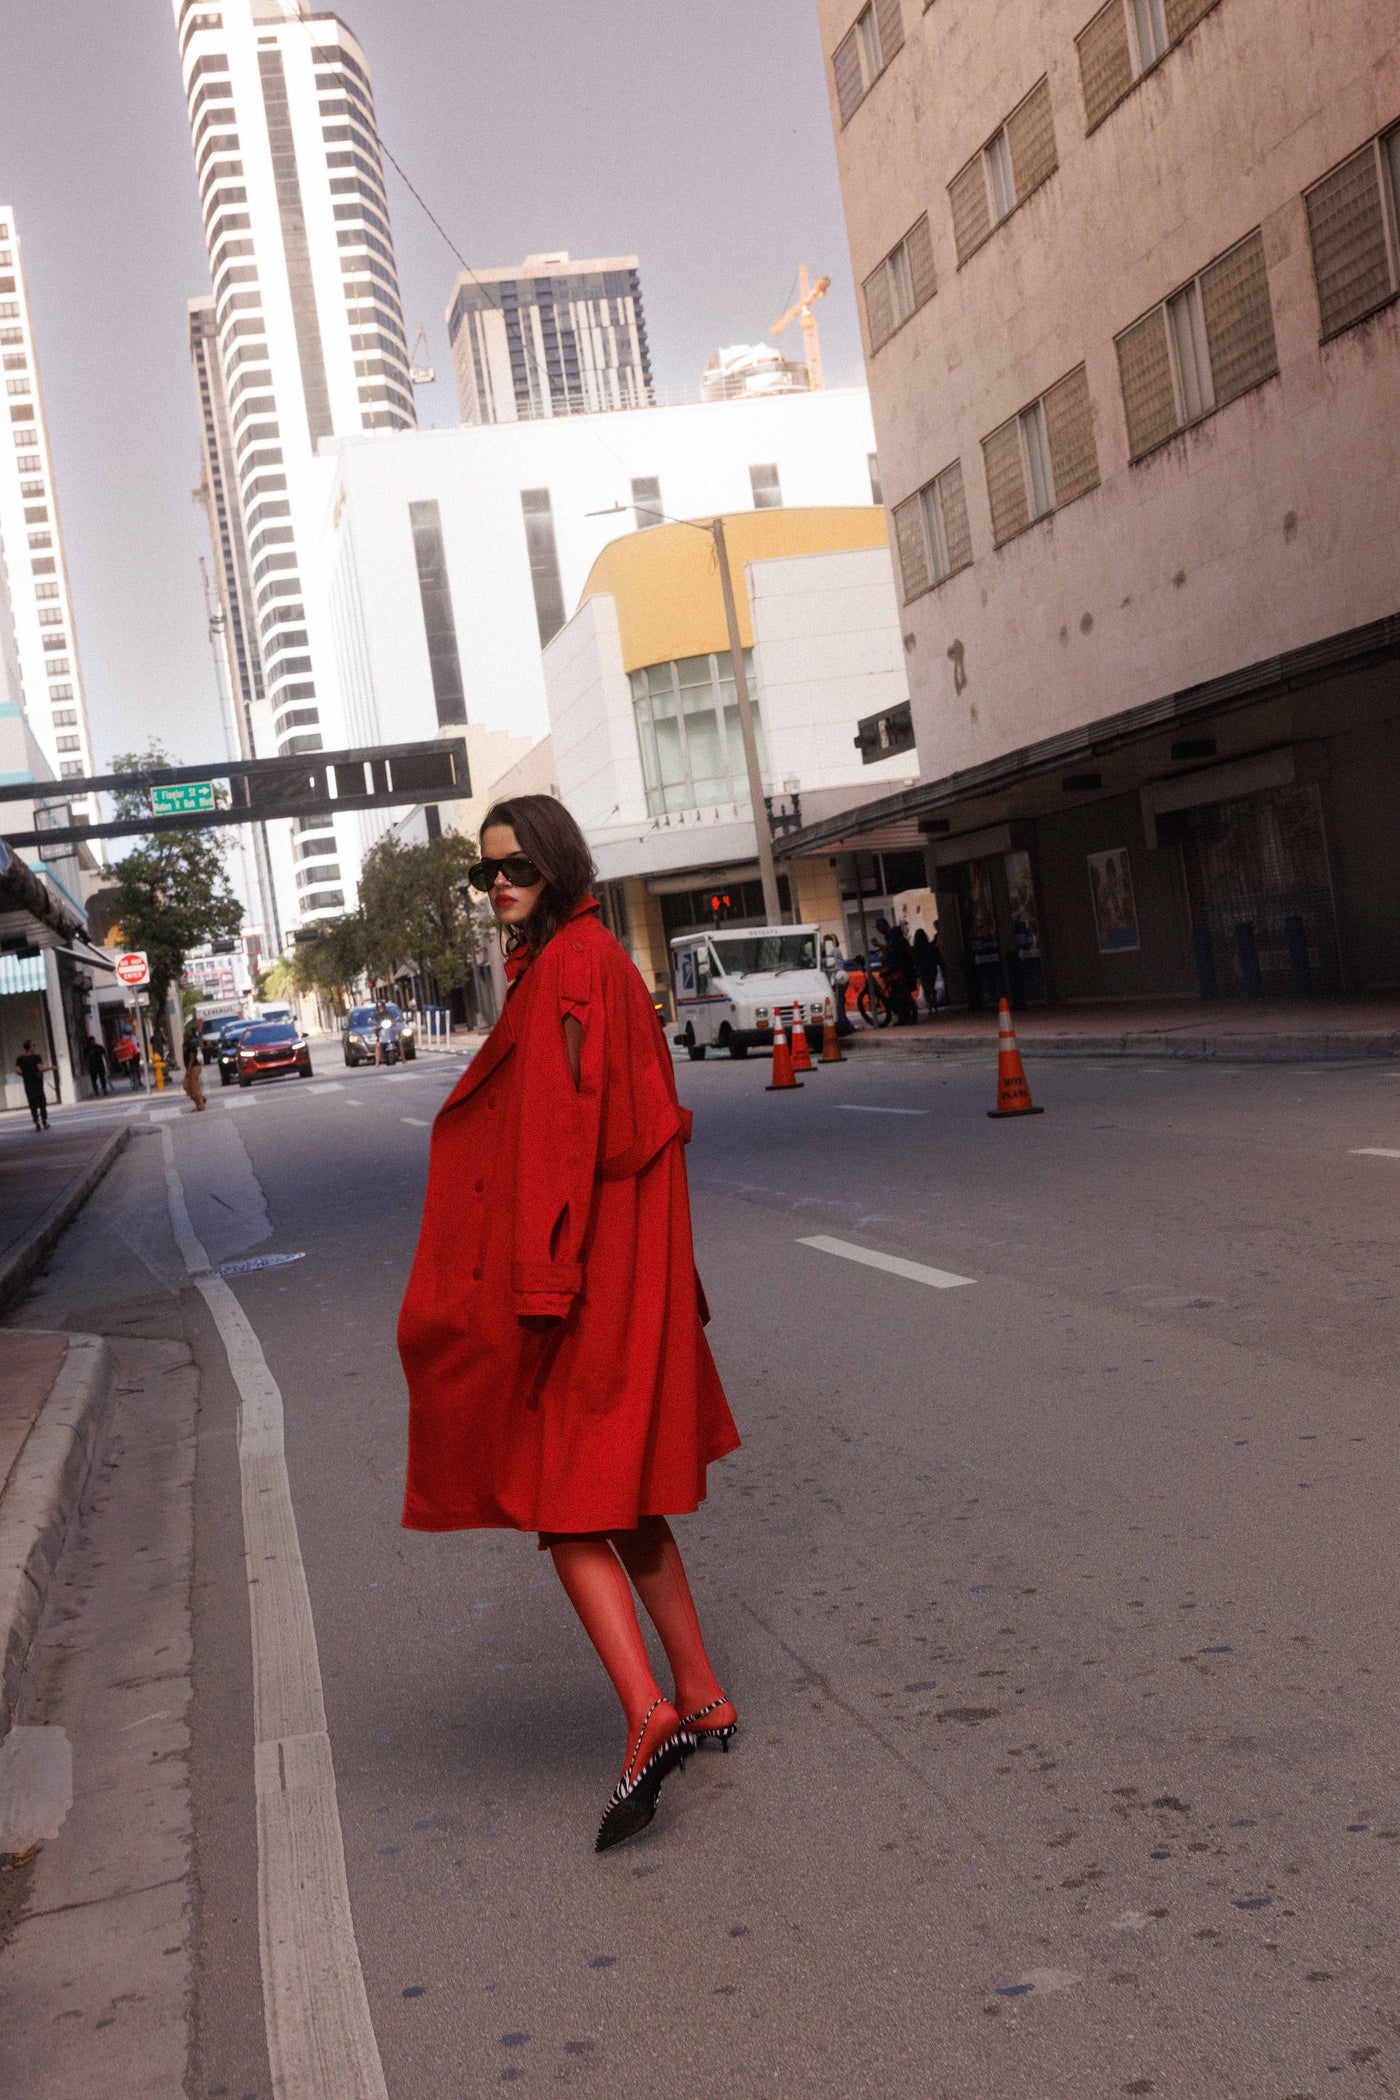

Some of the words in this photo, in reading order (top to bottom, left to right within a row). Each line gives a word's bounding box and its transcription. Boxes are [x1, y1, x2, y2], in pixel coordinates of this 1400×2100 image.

[153, 791, 158, 801] E
[162, 789, 184, 801] Flagler
[188, 787, 196, 797] St
